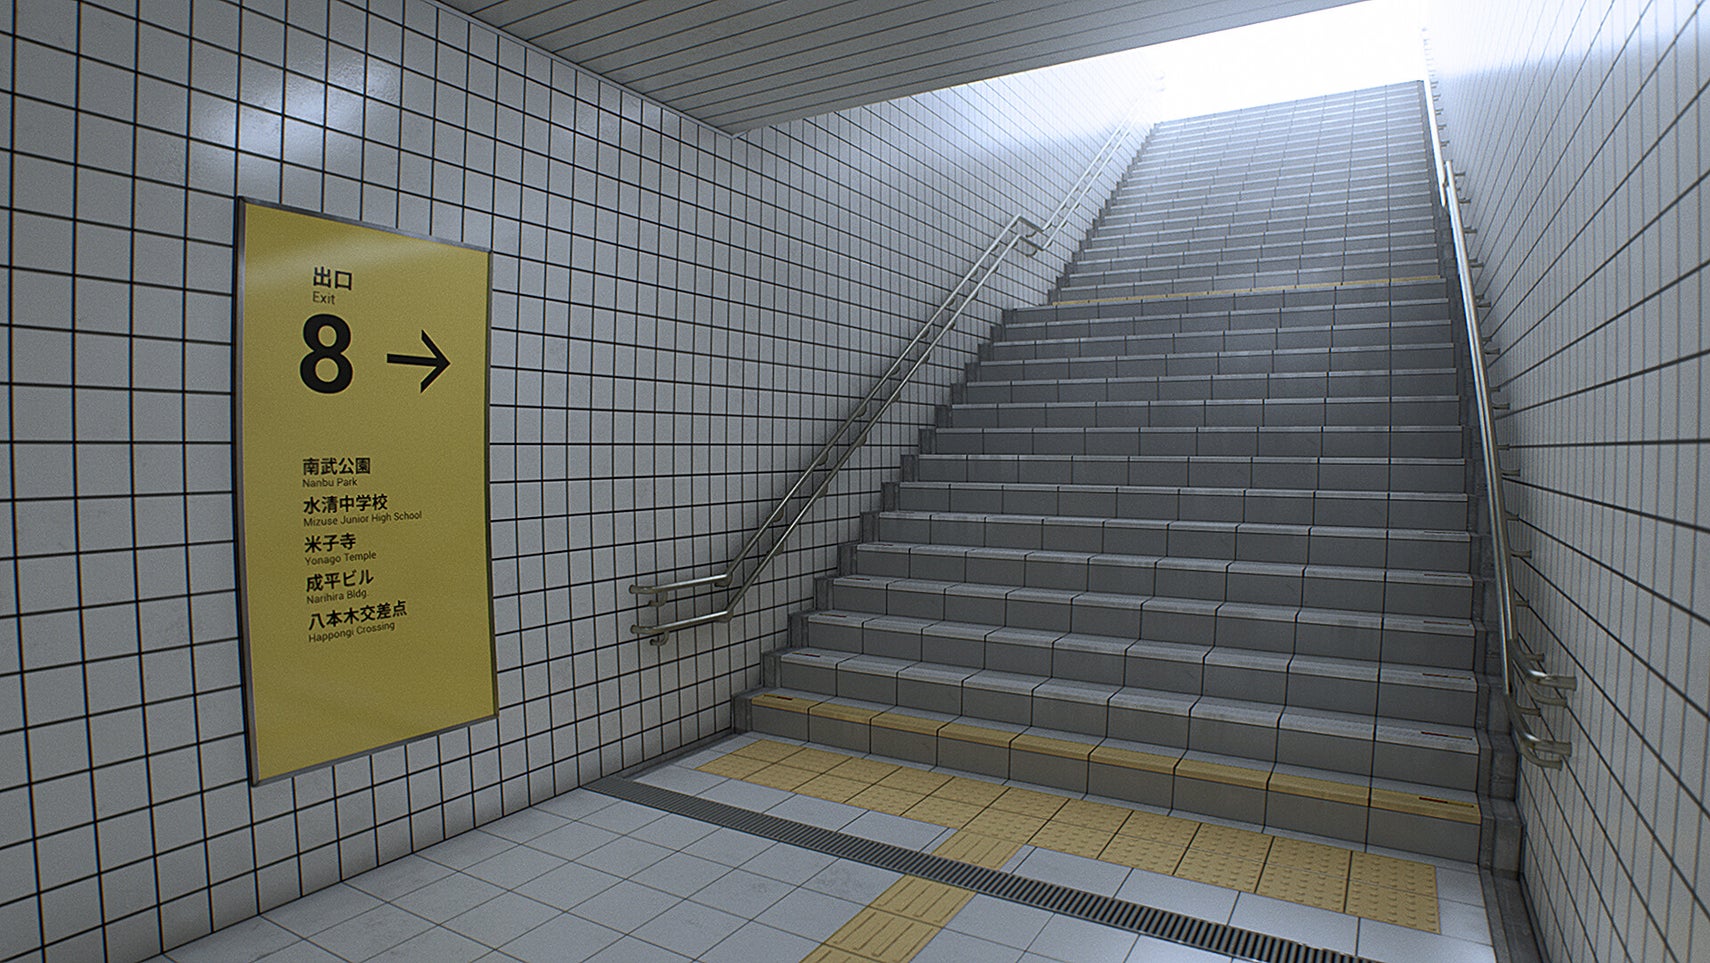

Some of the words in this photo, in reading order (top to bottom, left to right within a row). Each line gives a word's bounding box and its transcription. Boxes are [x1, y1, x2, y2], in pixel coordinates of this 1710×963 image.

[313, 266, 352, 290] 出口
[312, 291, 335, 304] Exit
[300, 313, 353, 394] 8
[303, 457, 370, 475] 南武公園
[302, 479, 334, 488] Nanbu
[337, 478, 357, 486] Park
[303, 518, 338, 527] Mizuse
[340, 516, 369, 525] Junior
[371, 513, 391, 524] High
[394, 511, 422, 520] School
[304, 533, 356, 553] 米子寺
[305, 556, 341, 566] Yonago
[345, 551, 376, 562] Temple
[306, 569, 374, 592] 成平ビル
[307, 593, 344, 604] Narihira
[308, 600, 407, 631] 八本木交差点
[308, 630, 354, 643] Happongi
[356, 622, 395, 635] Crossing
